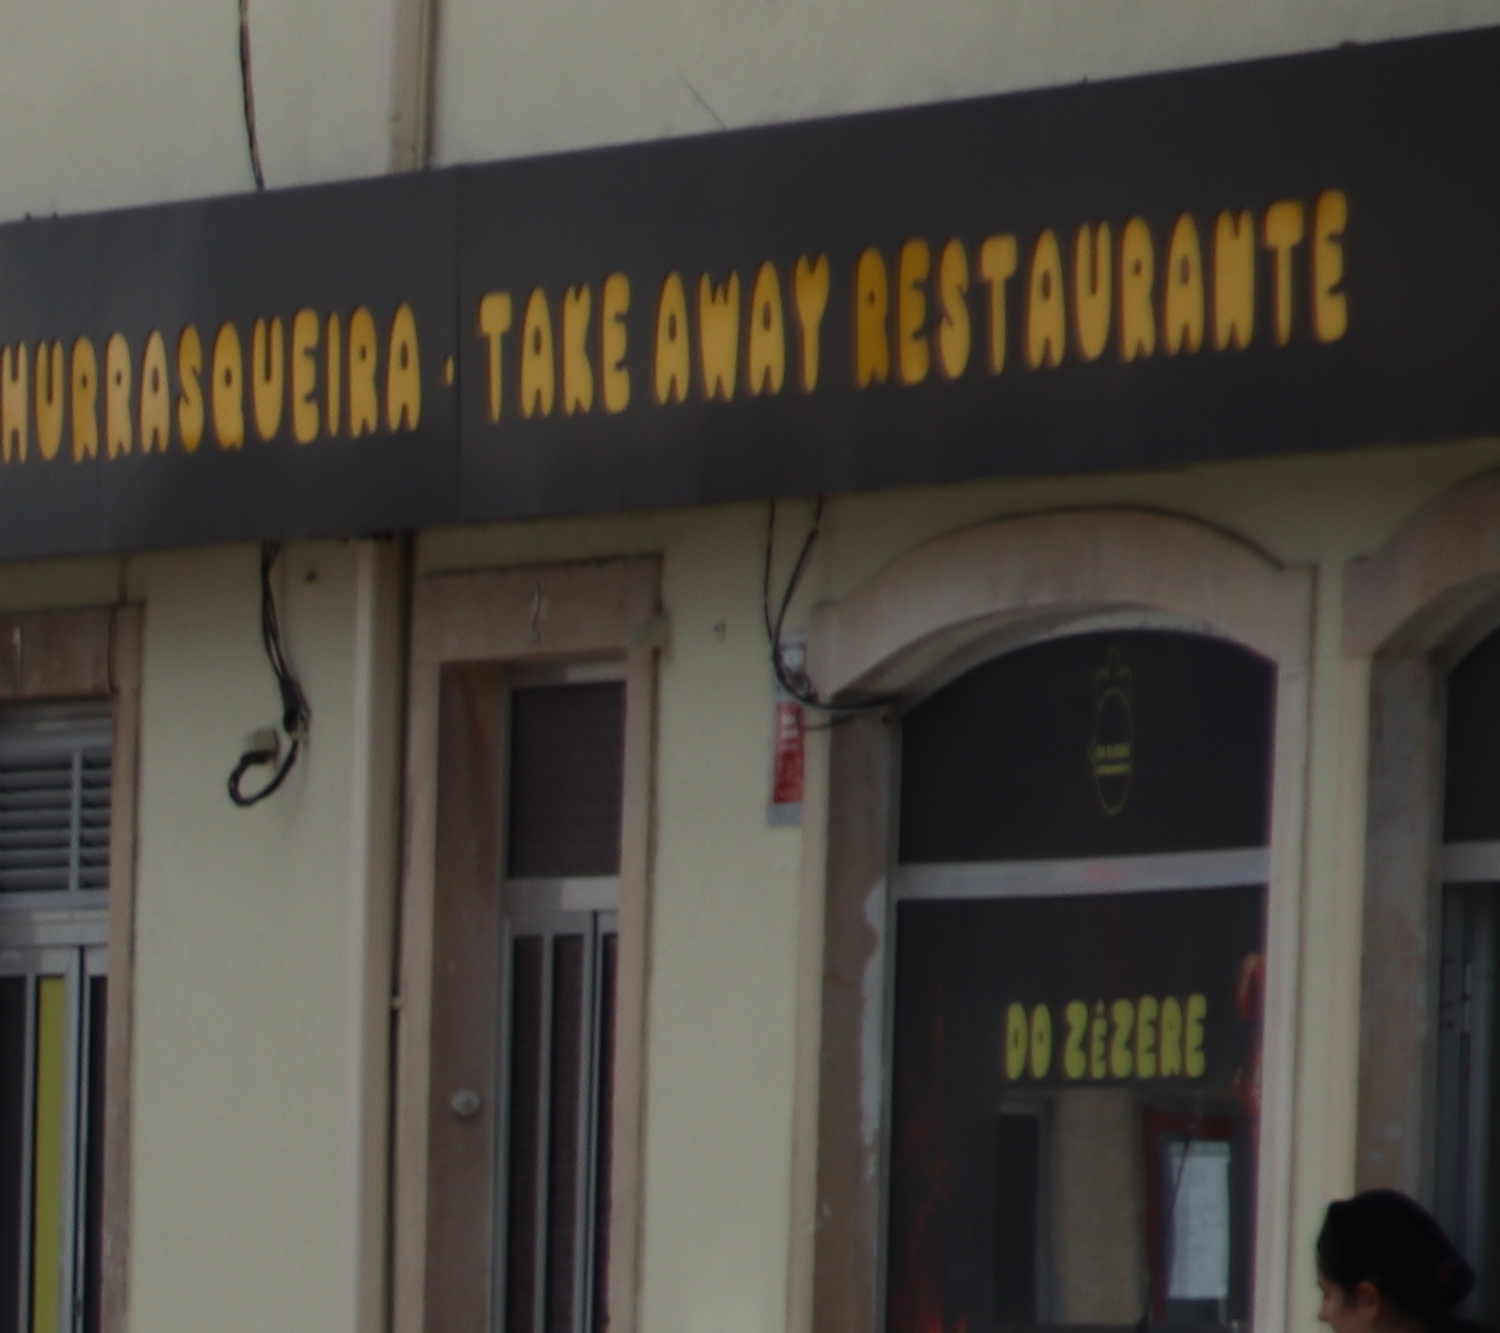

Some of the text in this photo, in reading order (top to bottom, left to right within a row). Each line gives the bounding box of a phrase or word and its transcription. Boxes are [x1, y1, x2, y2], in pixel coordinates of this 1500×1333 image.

[480, 273, 630, 423] TAKE
[655, 253, 830, 405] AWAY
[855, 188, 1348, 389] RESTAURANTE
[1005, 1001, 1053, 1081] DO
